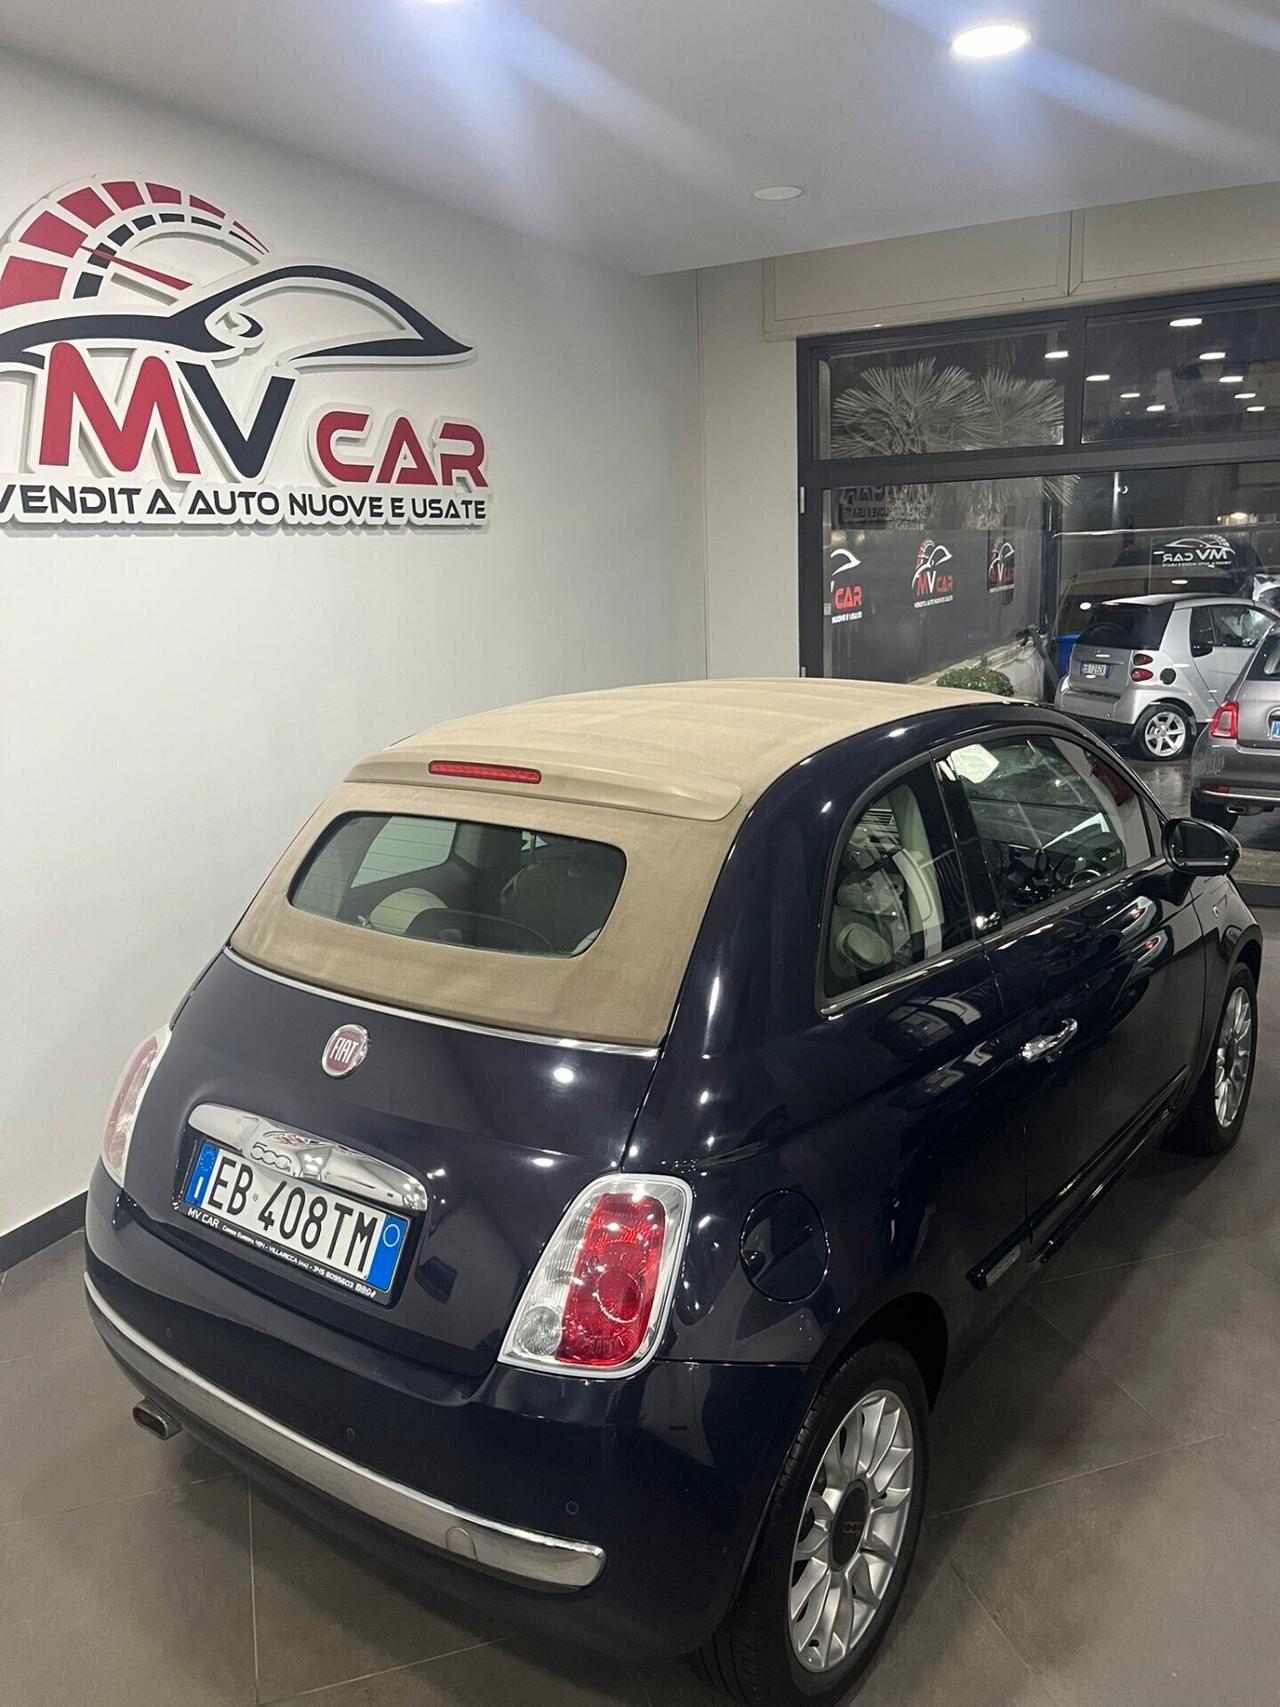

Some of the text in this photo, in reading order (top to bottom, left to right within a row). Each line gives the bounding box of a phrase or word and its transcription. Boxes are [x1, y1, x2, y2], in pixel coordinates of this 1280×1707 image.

[39, 342, 488, 487] MV CAR
[188, 489, 279, 515] AUTO
[289, 493, 383, 517] NUOVE
[391, 497, 404, 518] E
[411, 498, 486, 519] USATE
[835, 585, 862, 609] CAR
[917, 570, 953, 597] MV CAR
[330, 1036, 359, 1064] FIAT
[250, 1142, 293, 1171] 500
[187, 1208, 202, 1220] MV
[202, 1214, 220, 1229] CAR
[207, 1156, 378, 1273] EB 408TM
